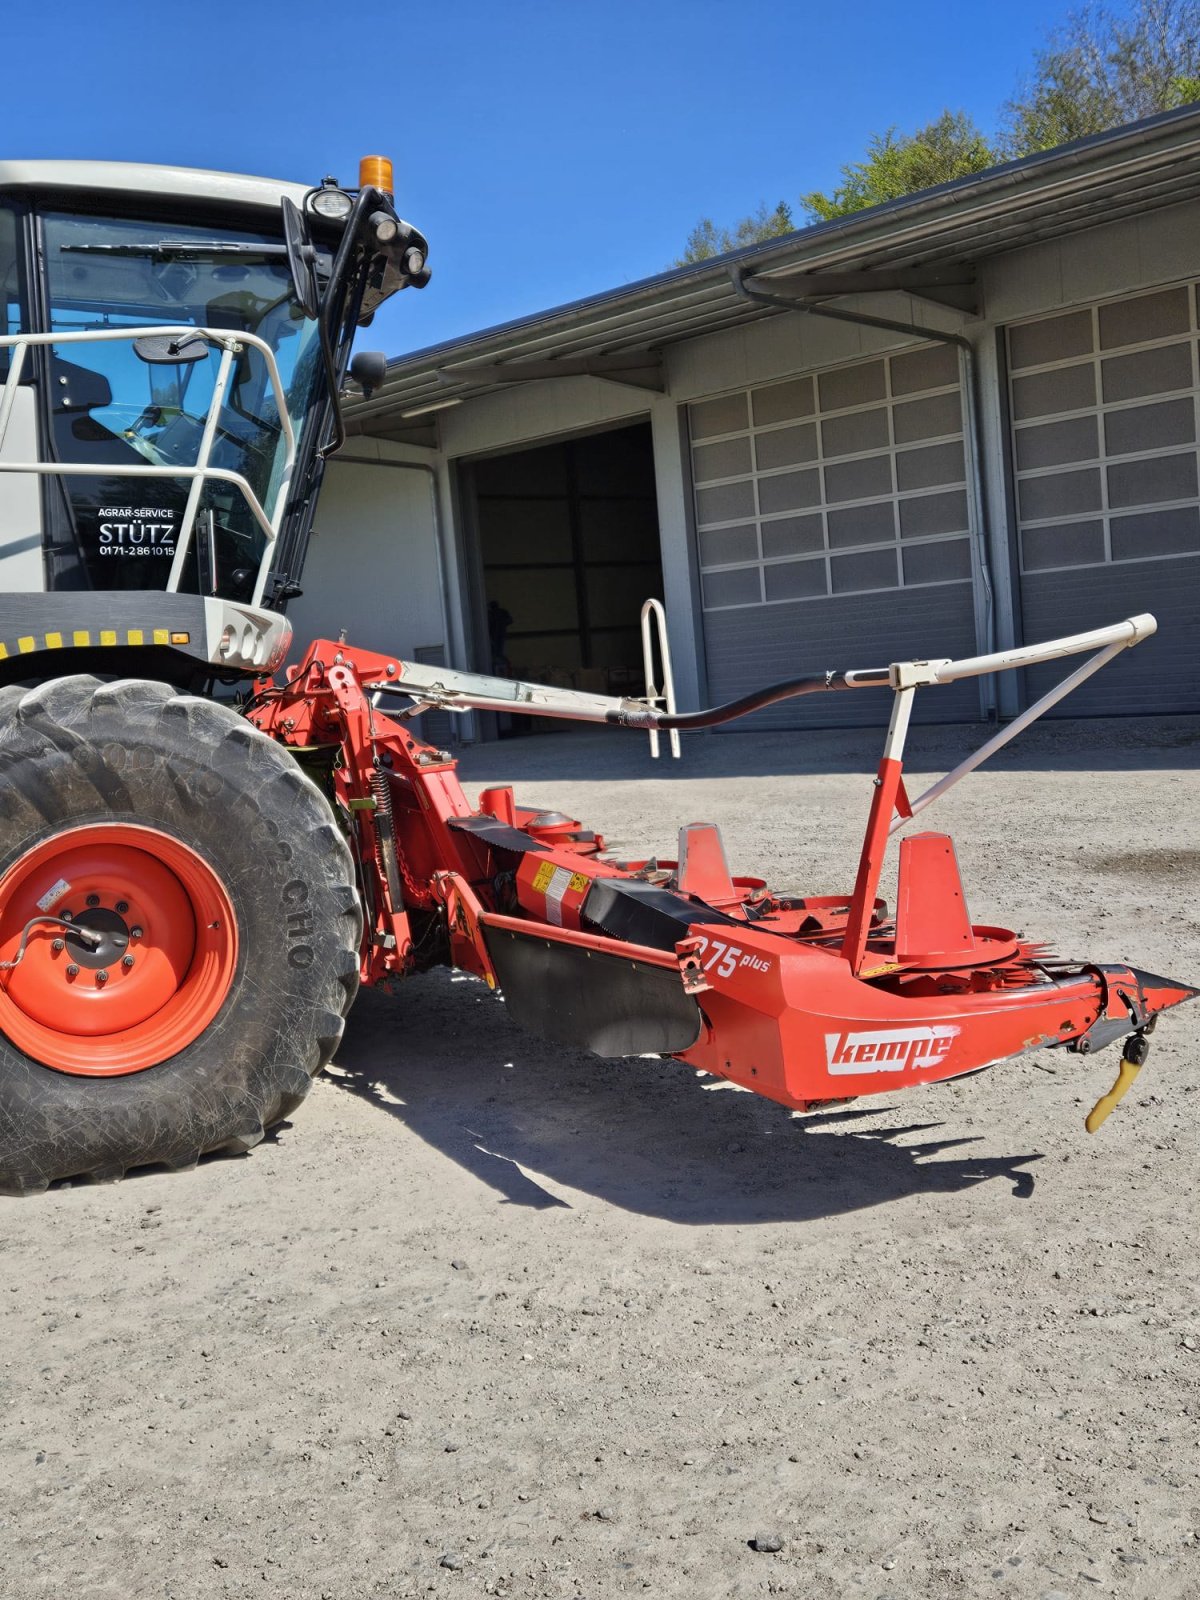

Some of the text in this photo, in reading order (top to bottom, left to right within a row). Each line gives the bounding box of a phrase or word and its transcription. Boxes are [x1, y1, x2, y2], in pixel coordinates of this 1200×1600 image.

[98, 508, 174, 518] AGRAR-SERVICE
[99, 519, 174, 544] STÜTZ
[739, 954, 771, 973] plus
